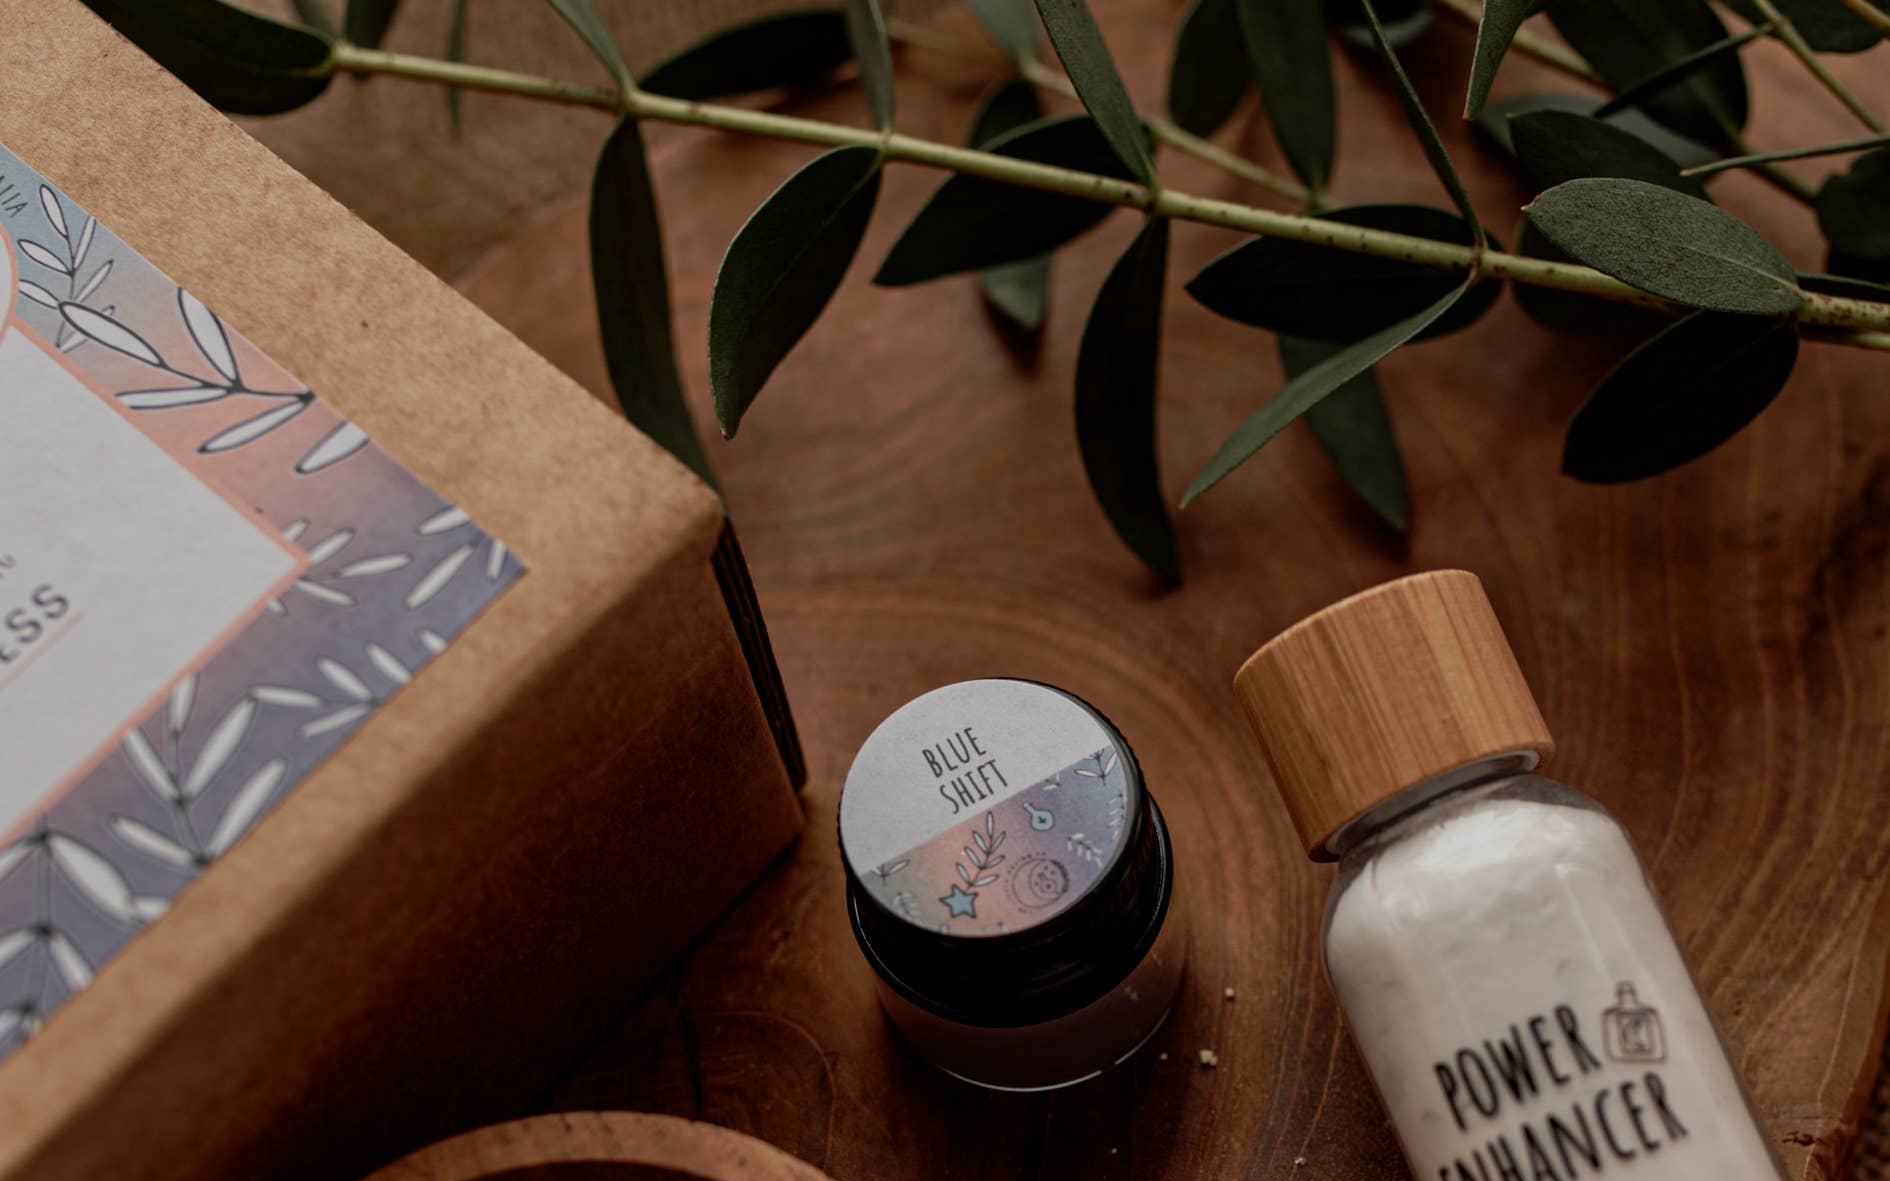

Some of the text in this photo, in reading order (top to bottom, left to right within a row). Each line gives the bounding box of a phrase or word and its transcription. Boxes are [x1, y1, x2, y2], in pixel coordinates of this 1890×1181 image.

[921, 727, 987, 779] BLUE
[940, 759, 1009, 815] SHIFT
[1433, 1003, 1602, 1133] POWER
